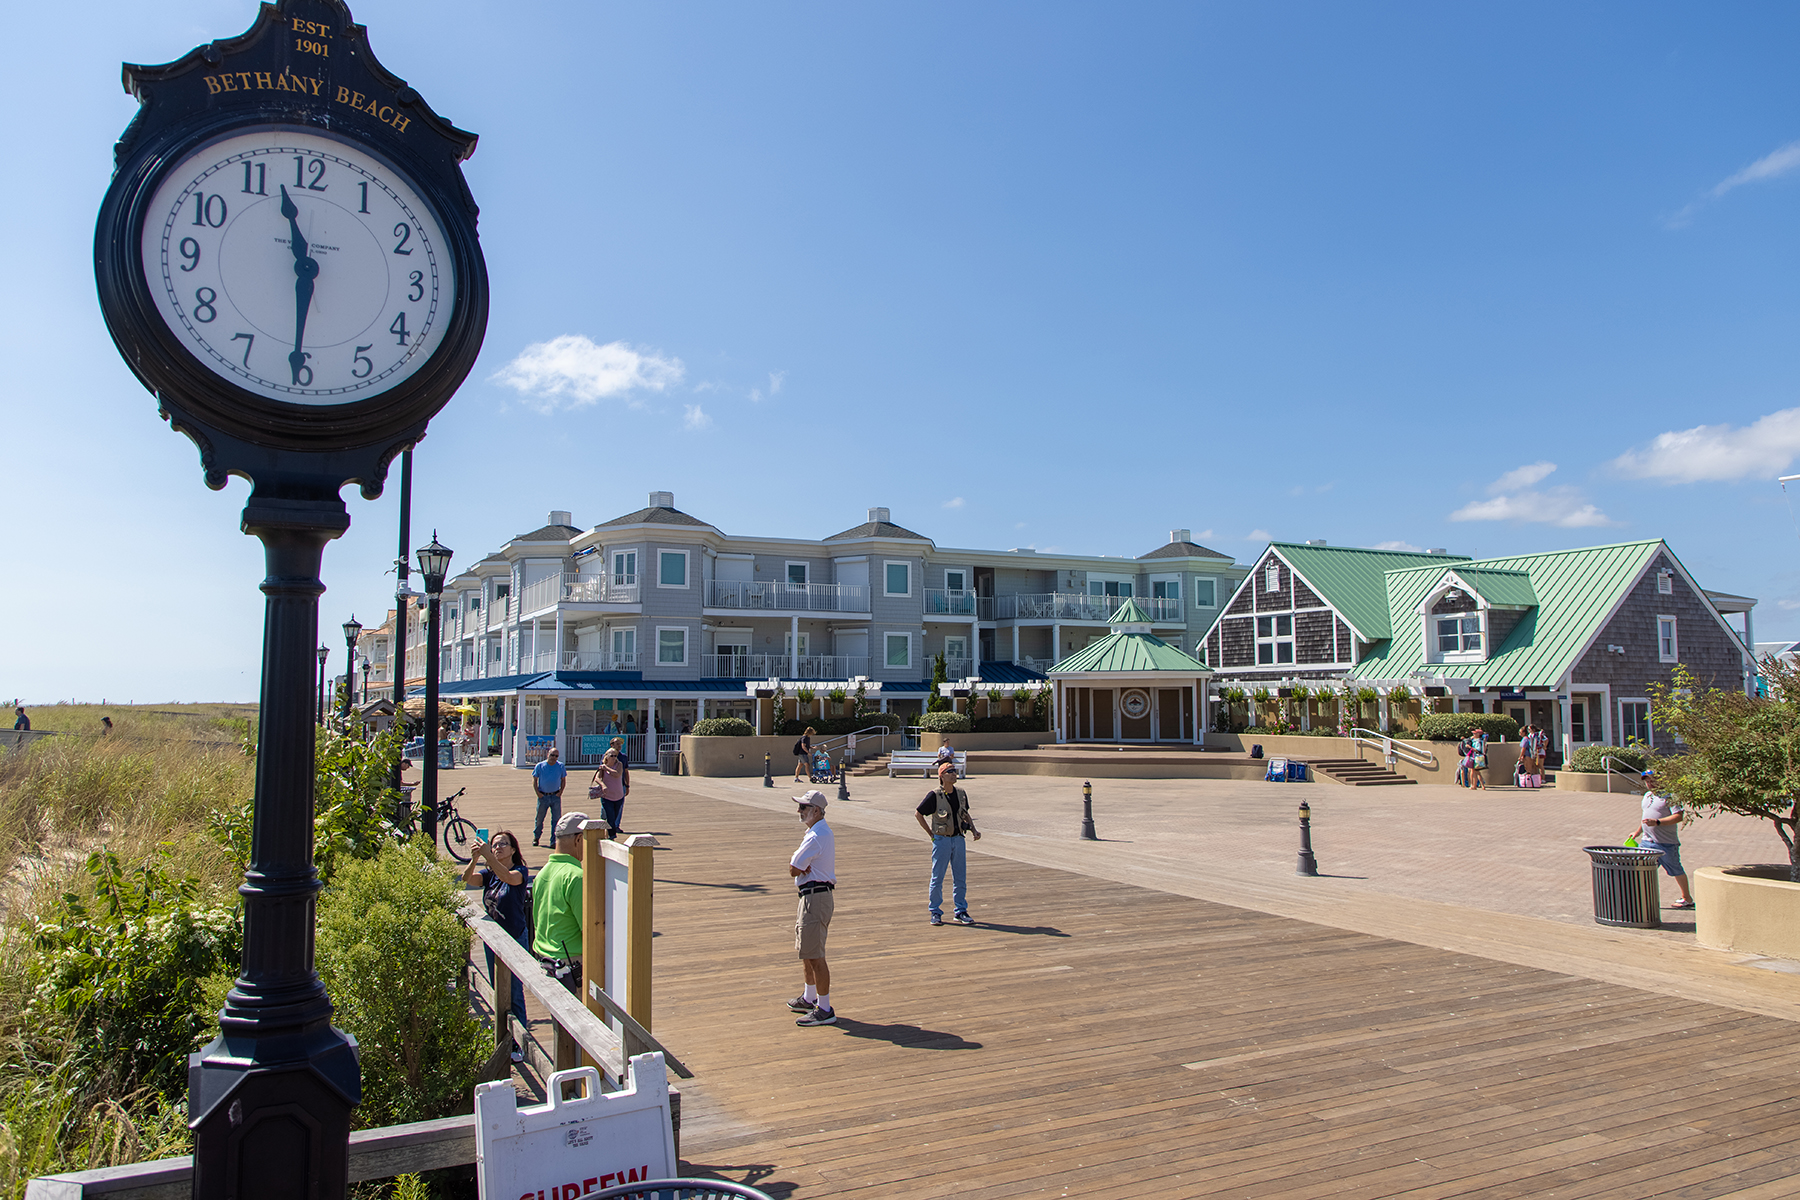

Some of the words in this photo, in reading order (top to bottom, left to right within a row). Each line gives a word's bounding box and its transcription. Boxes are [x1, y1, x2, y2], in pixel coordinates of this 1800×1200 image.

[291, 17, 333, 39] EST.
[295, 38, 329, 58] 1901
[203, 71, 324, 96] BETHANY
[335, 85, 412, 133] BEACH
[241, 161, 269, 196] 11
[293, 155, 328, 191] 12
[192, 192, 227, 228] 10
[358, 181, 371, 214] 1
[179, 237, 200, 272] 9
[393, 223, 413, 255] 2
[408, 270, 424, 302] 3
[193, 287, 217, 323] 8
[389, 312, 410, 346] 4
[230, 333, 255, 370] 7
[351, 344, 373, 378] 5
[297, 352, 313, 387] 6
